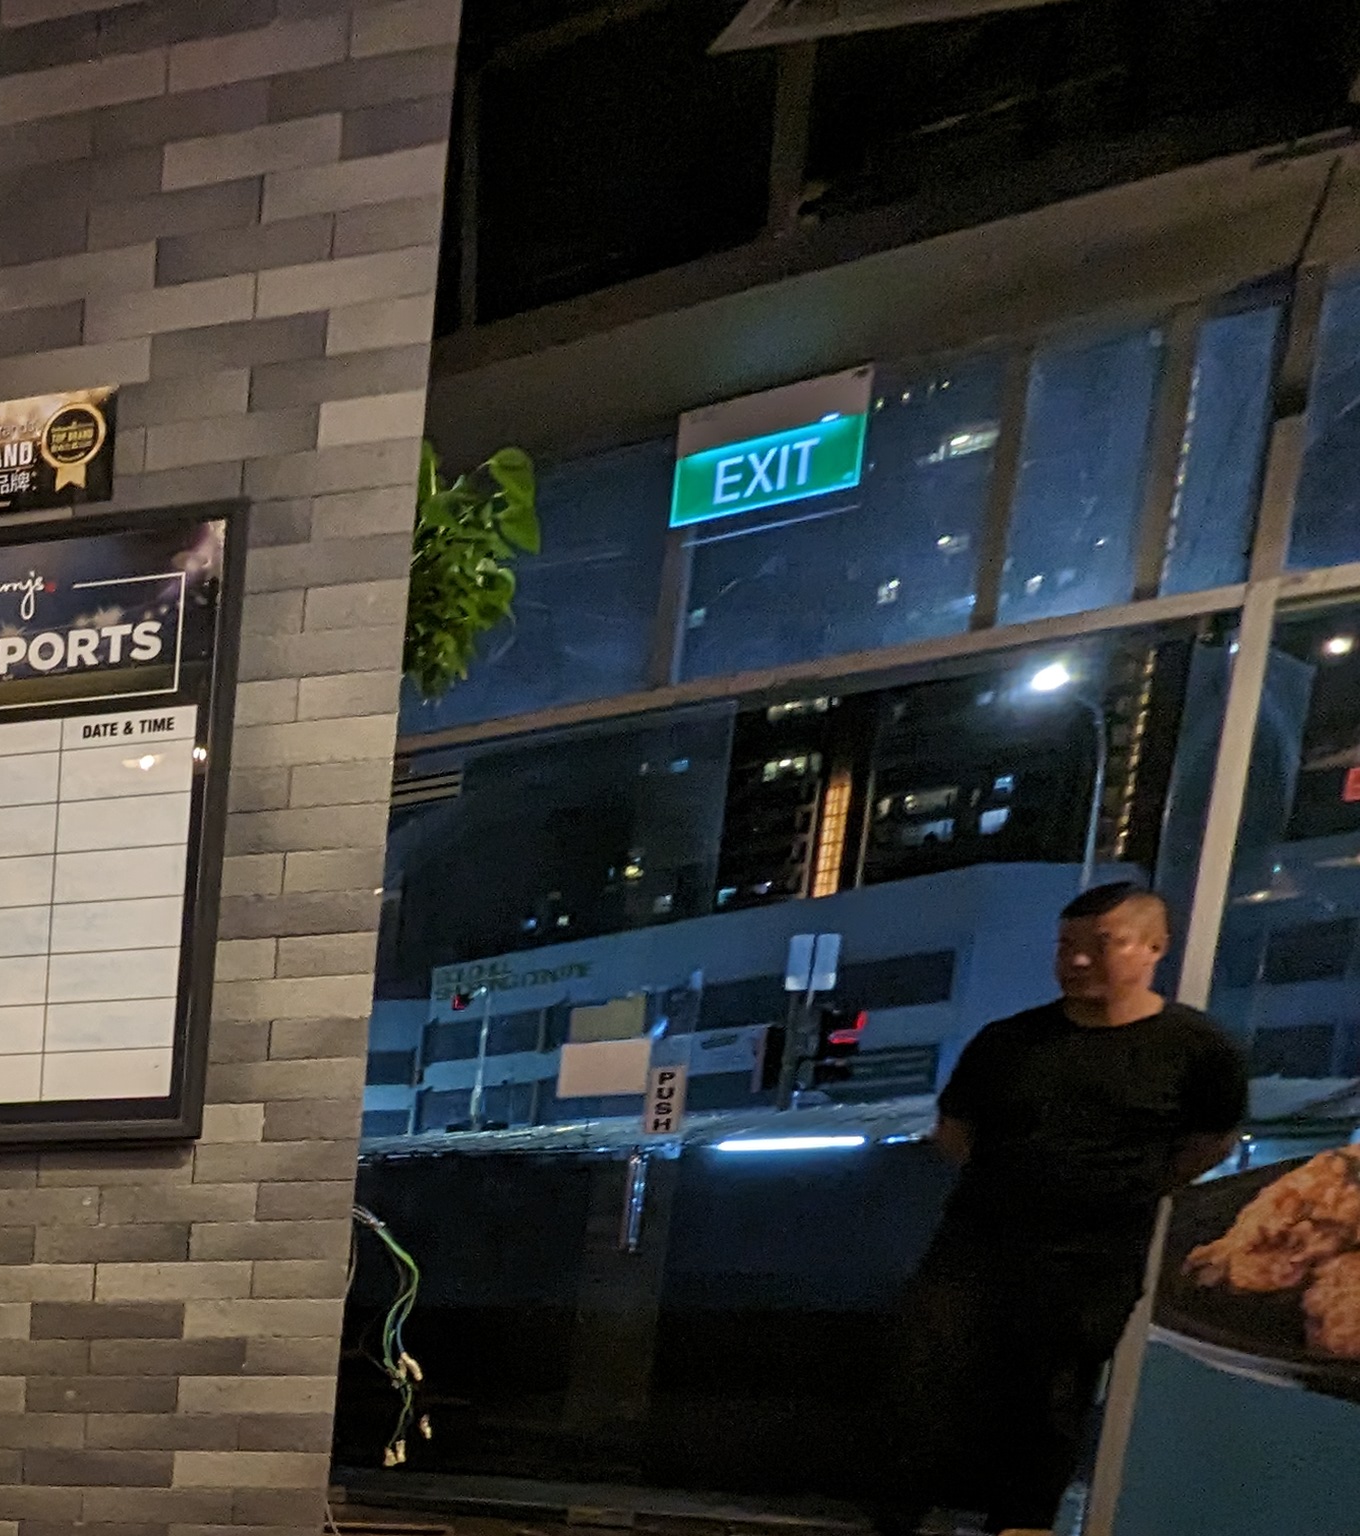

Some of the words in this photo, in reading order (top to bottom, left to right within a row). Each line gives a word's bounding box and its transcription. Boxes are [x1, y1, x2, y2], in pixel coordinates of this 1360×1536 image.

[713, 437, 821, 505] EXIT
[82, 722, 118, 740] DATE
[123, 720, 134, 735] &
[139, 716, 175, 734] TIME
[652, 1072, 676, 1131] PUSH
